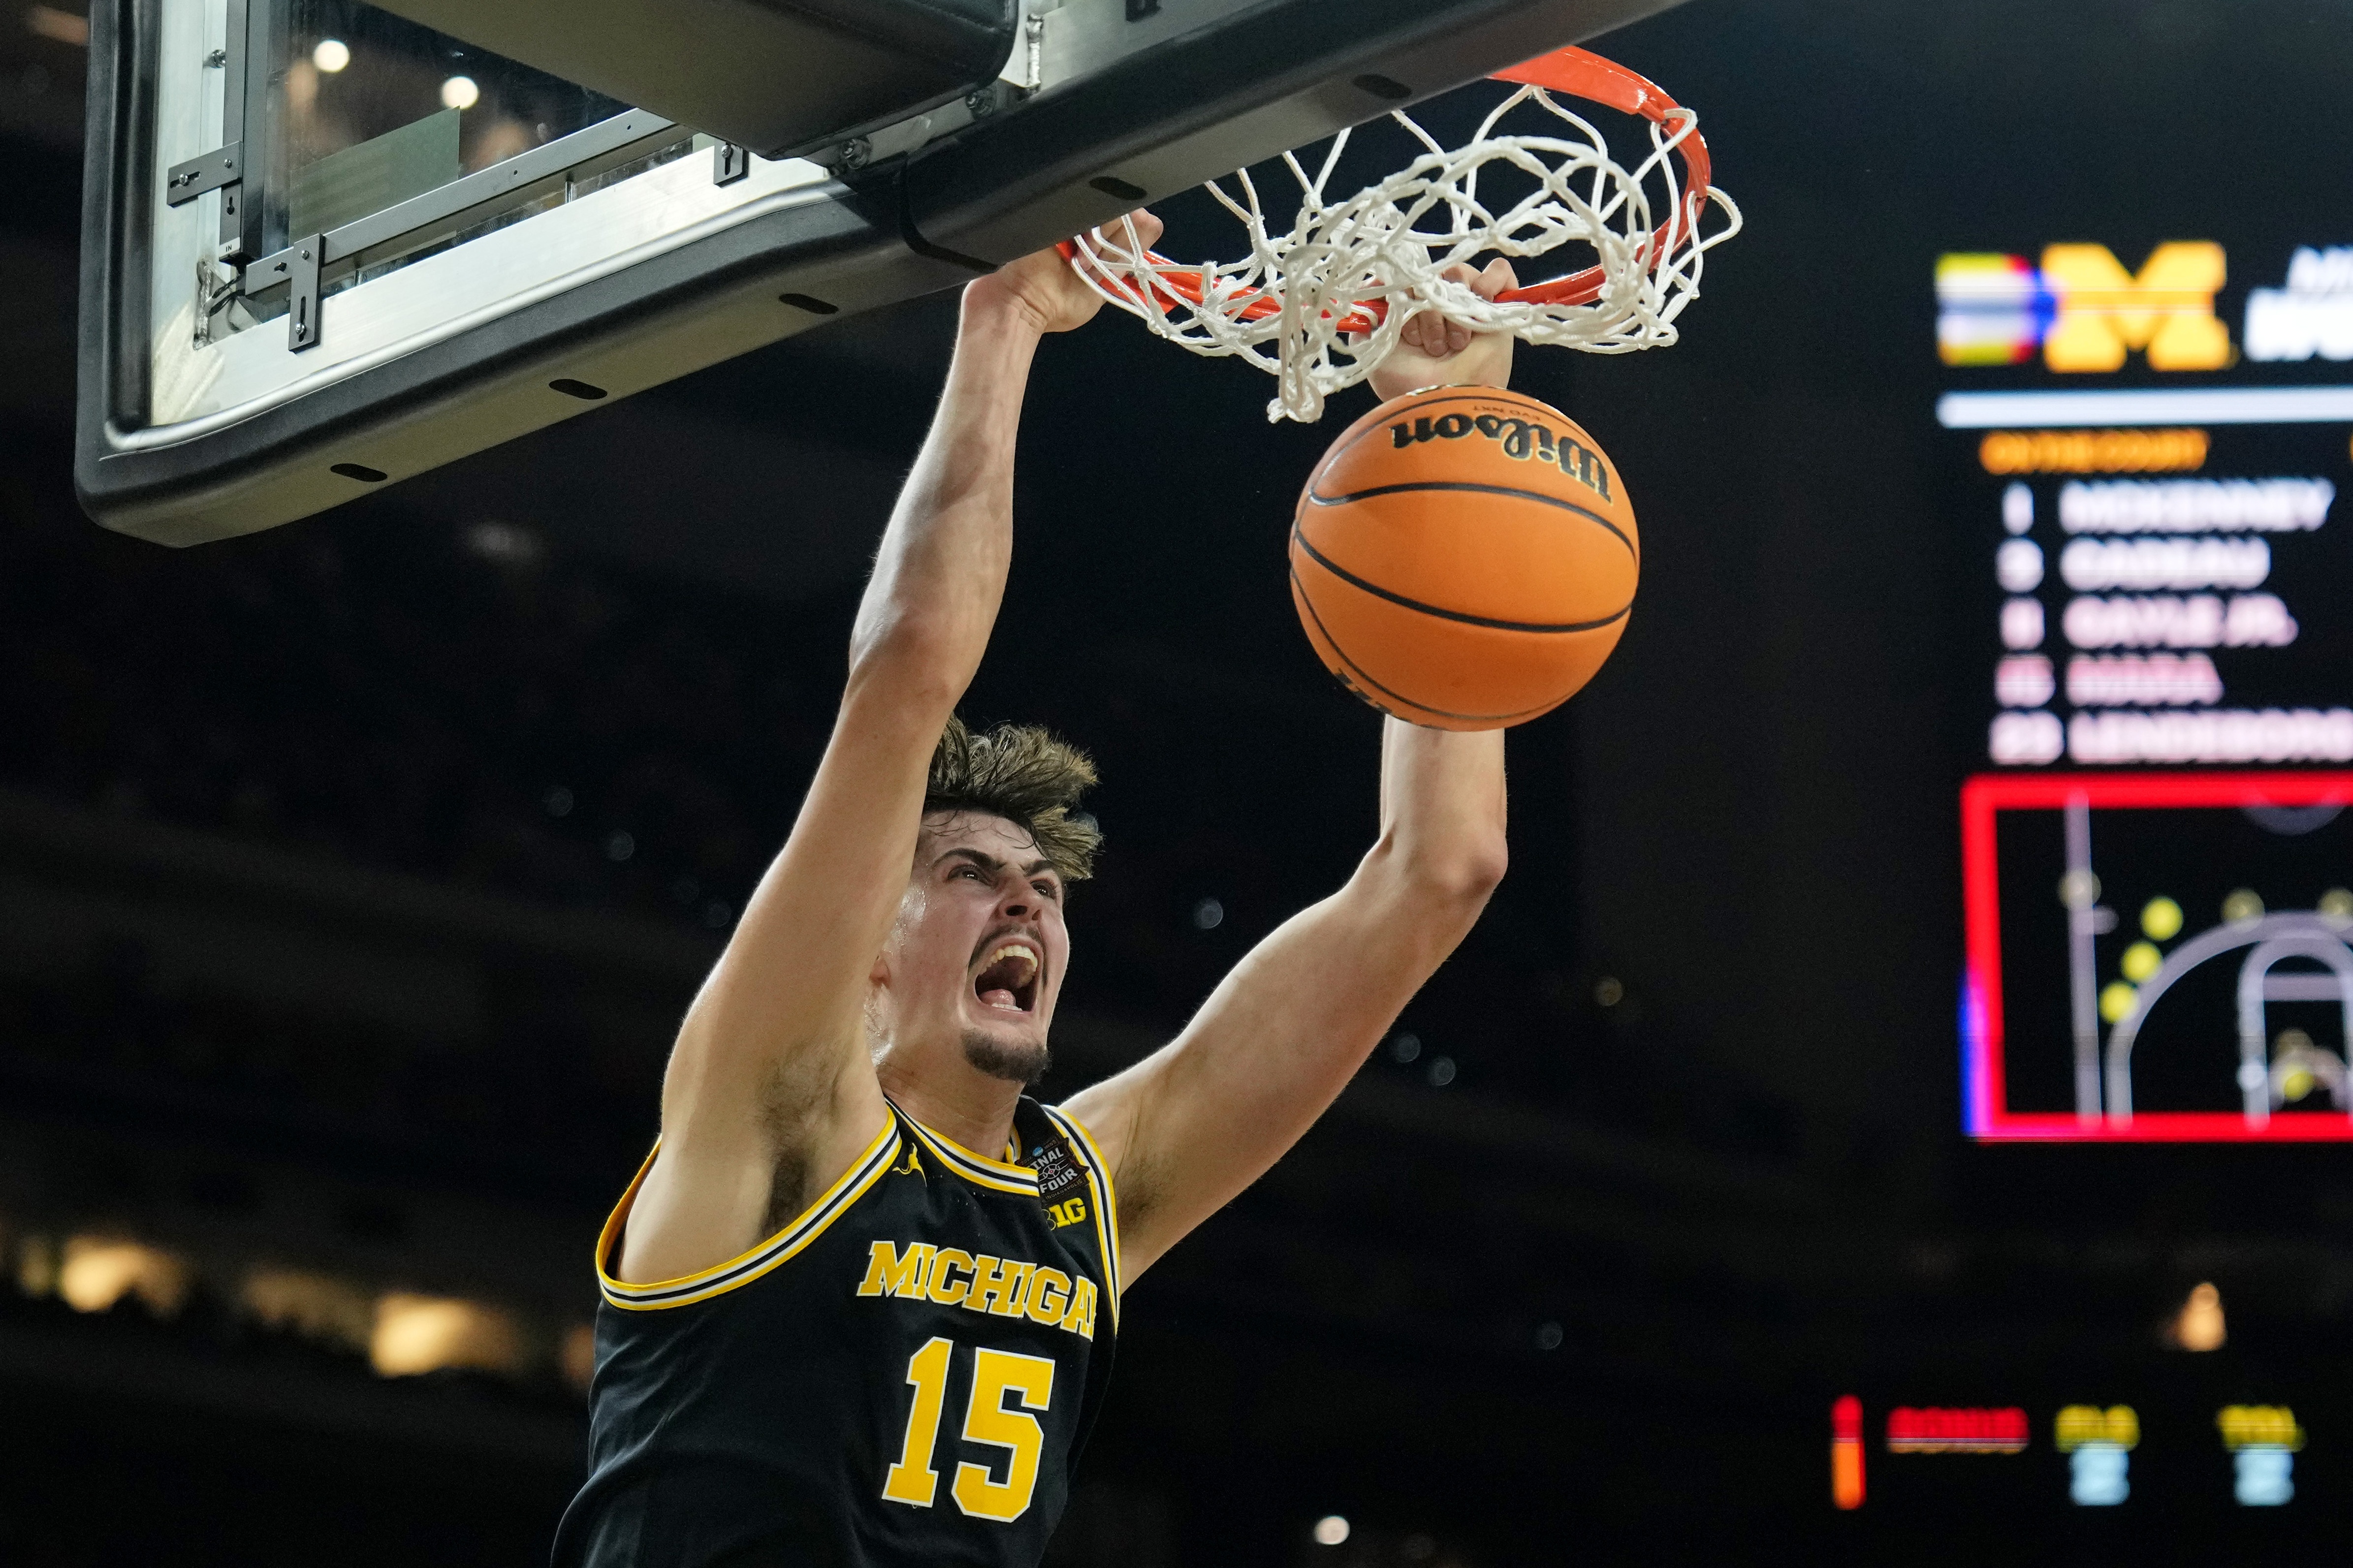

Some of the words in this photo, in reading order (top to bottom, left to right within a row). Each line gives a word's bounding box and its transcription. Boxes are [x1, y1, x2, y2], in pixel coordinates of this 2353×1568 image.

[2040, 241, 2228, 373] M
[1389, 413, 1613, 506] Wilson
[1027, 1147, 1064, 1170] INAL
[1039, 1168, 1078, 1193] FOUR
[882, 1336, 1055, 1523] 15
